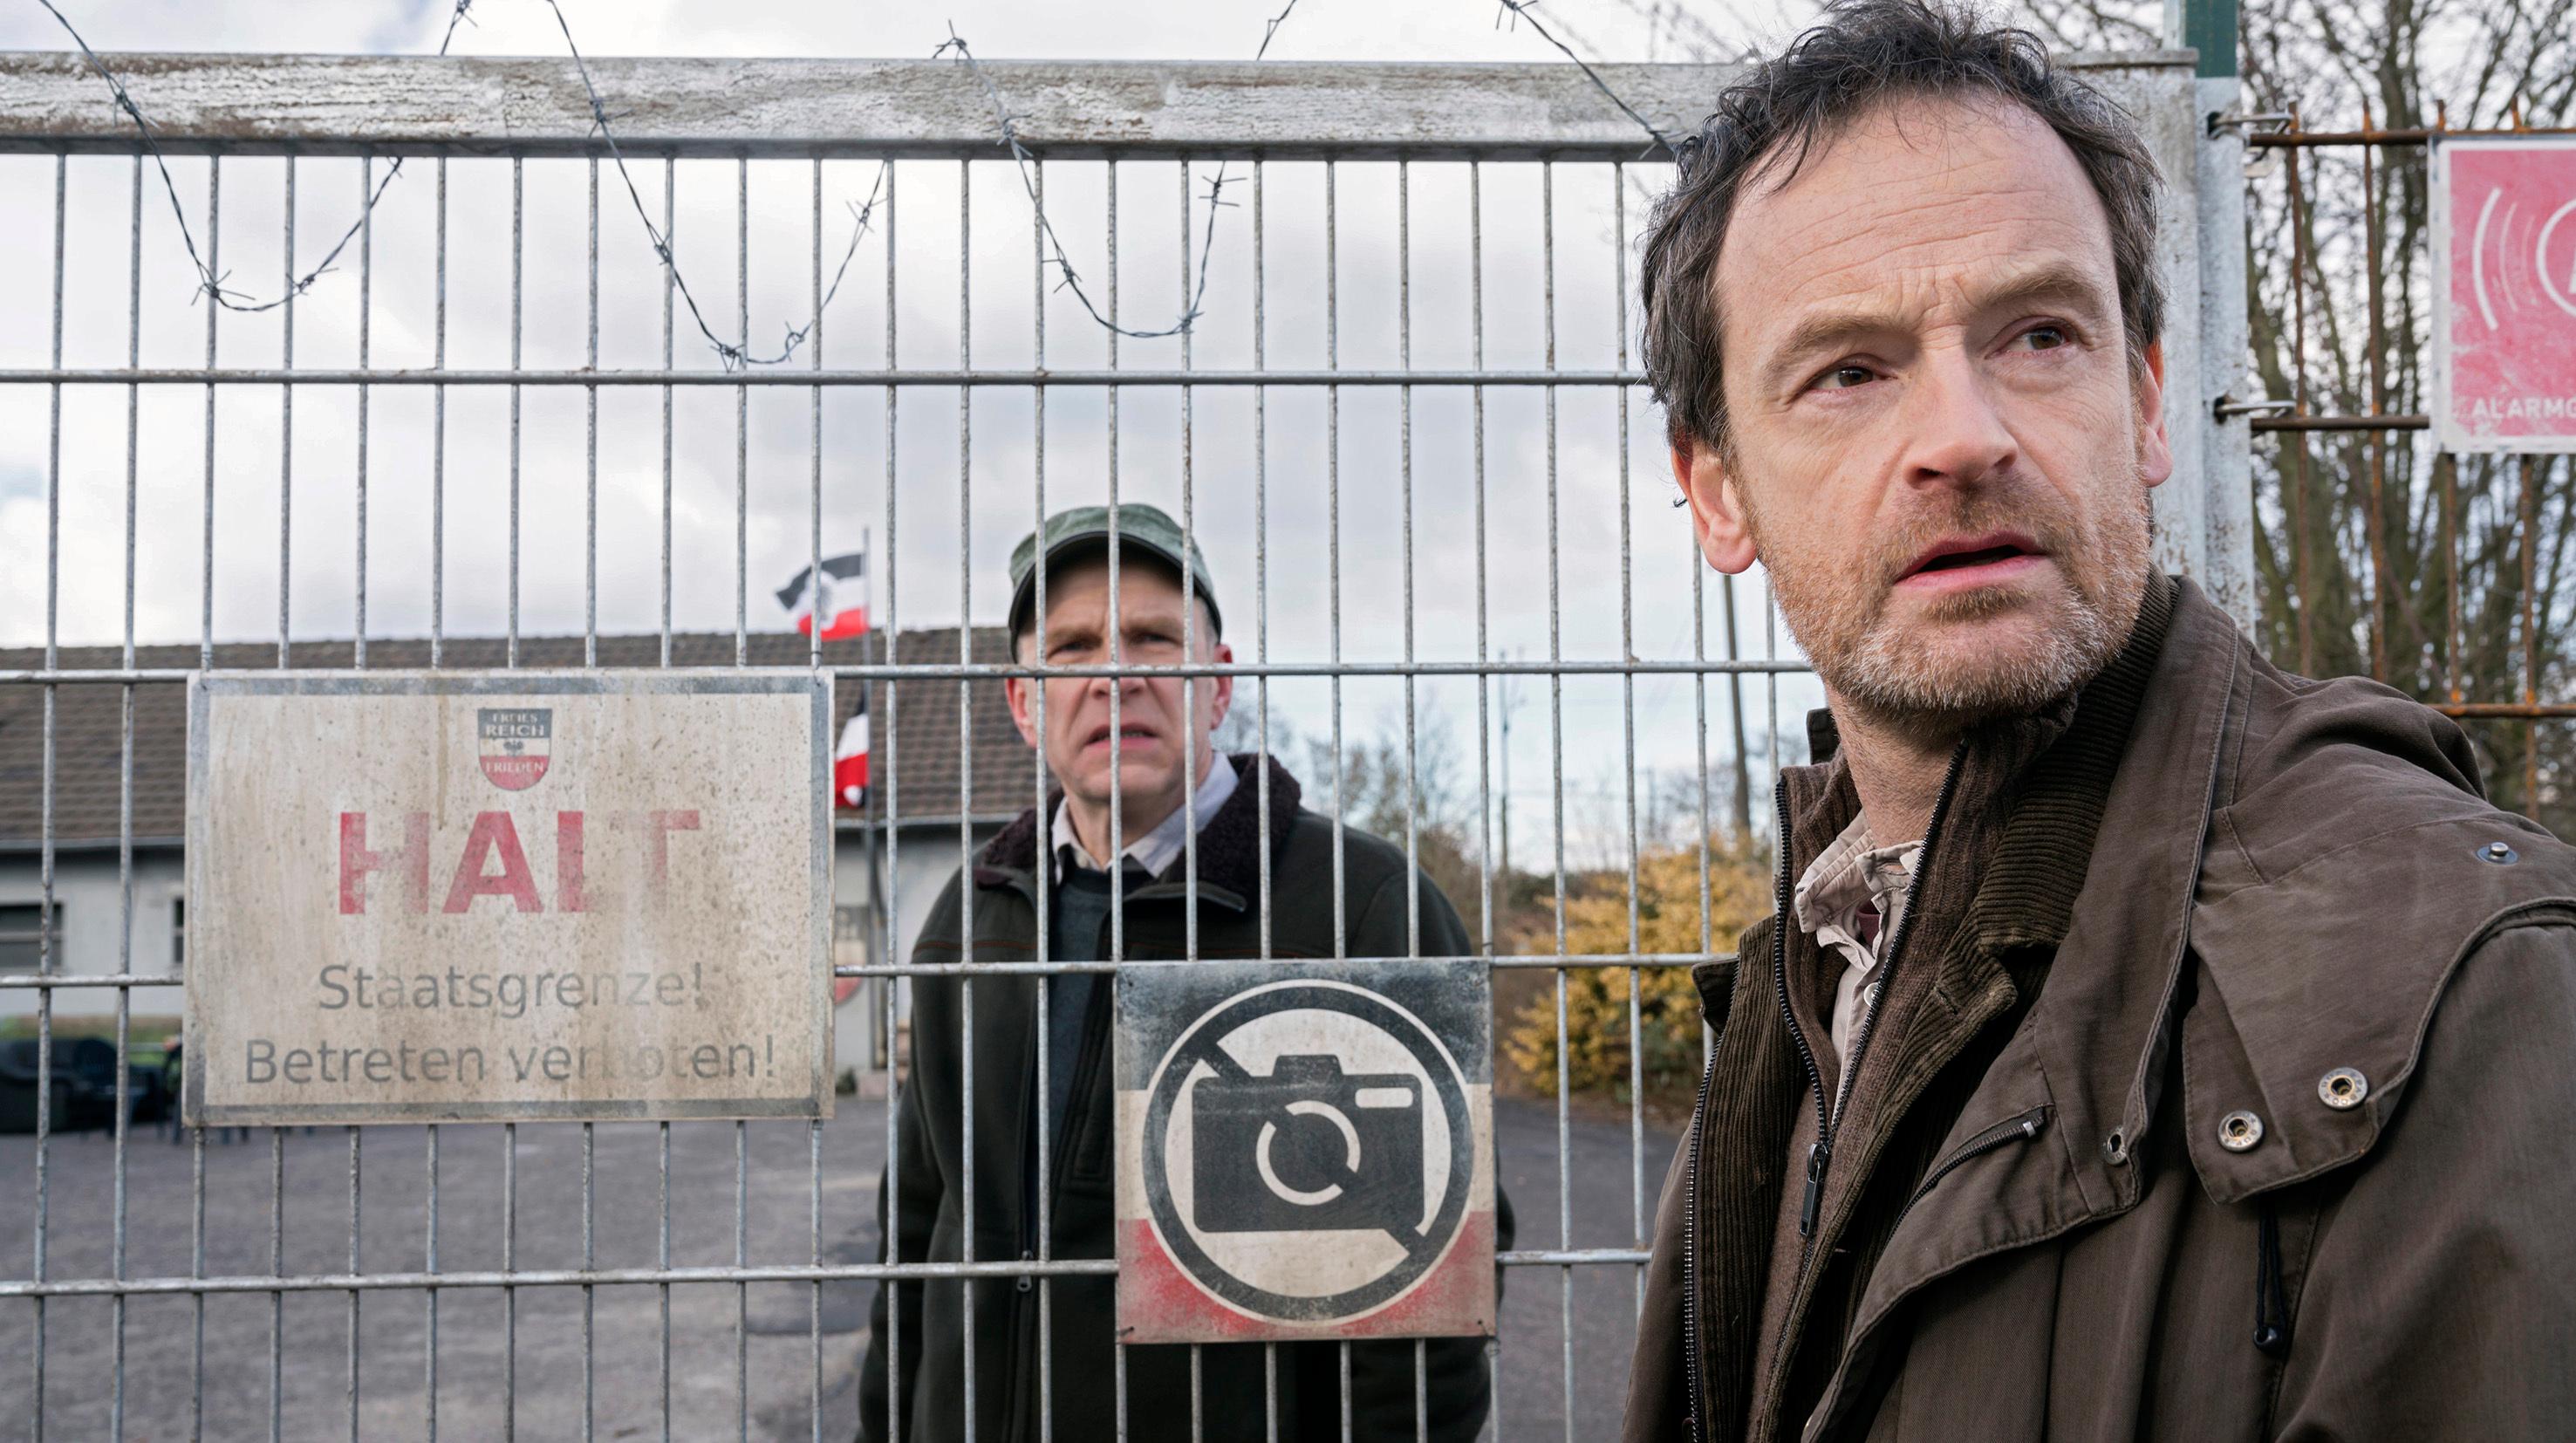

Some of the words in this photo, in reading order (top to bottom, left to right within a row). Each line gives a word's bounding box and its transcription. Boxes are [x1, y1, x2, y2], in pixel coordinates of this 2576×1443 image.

[485, 724, 545, 736] REICH
[485, 761, 545, 773] FRIEDEN
[339, 810, 700, 914] HALT
[318, 961, 702, 1019] Staatsgrenze!
[246, 1038, 485, 1084] Betreten
